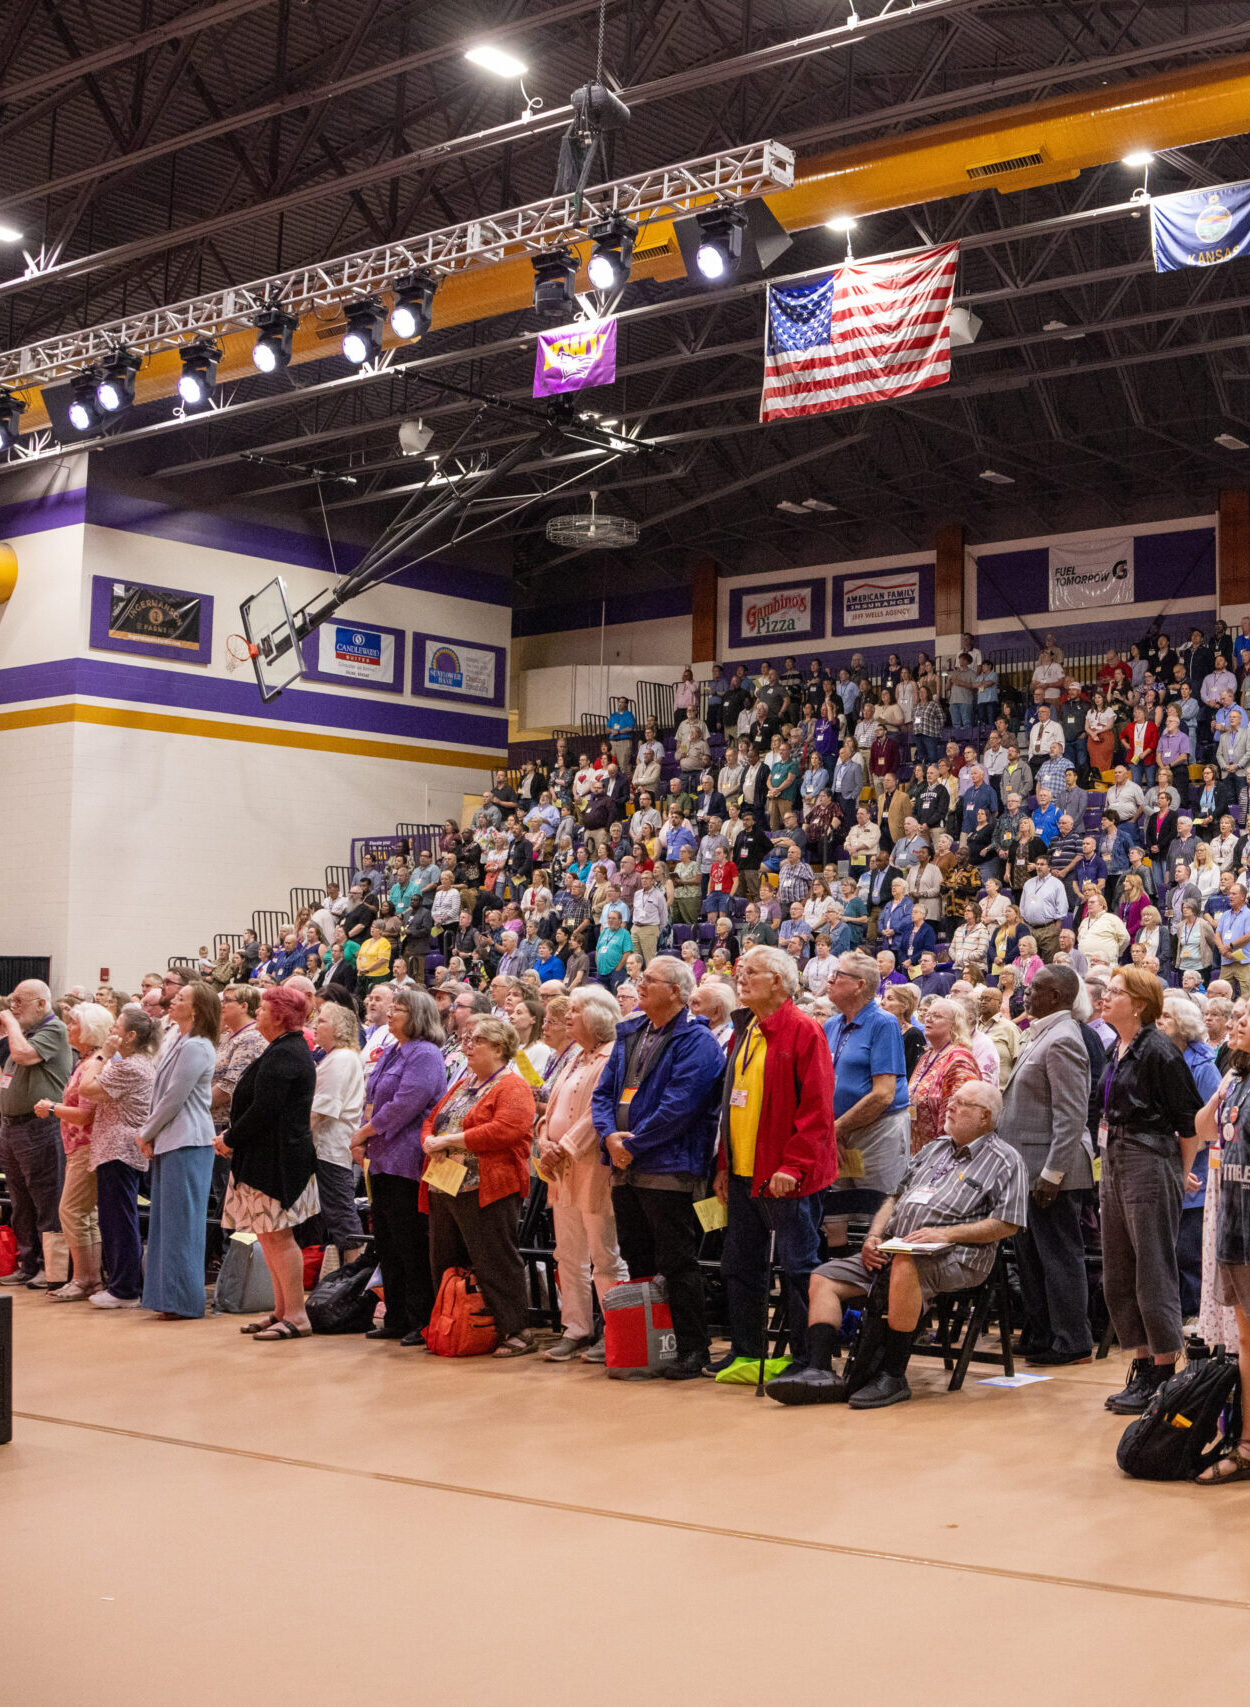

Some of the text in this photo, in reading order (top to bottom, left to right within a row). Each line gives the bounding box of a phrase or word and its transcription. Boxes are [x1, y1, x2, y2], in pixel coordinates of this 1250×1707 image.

[1187, 245, 1241, 265] KANSAS
[1055, 566, 1076, 577] FUEL
[846, 588, 916, 605] AMERICAN FAMILY
[850, 599, 911, 610] INSURANCE
[866, 610, 884, 618] WELLS
[886, 607, 910, 617] AGENCY
[756, 616, 796, 635] Pizza
